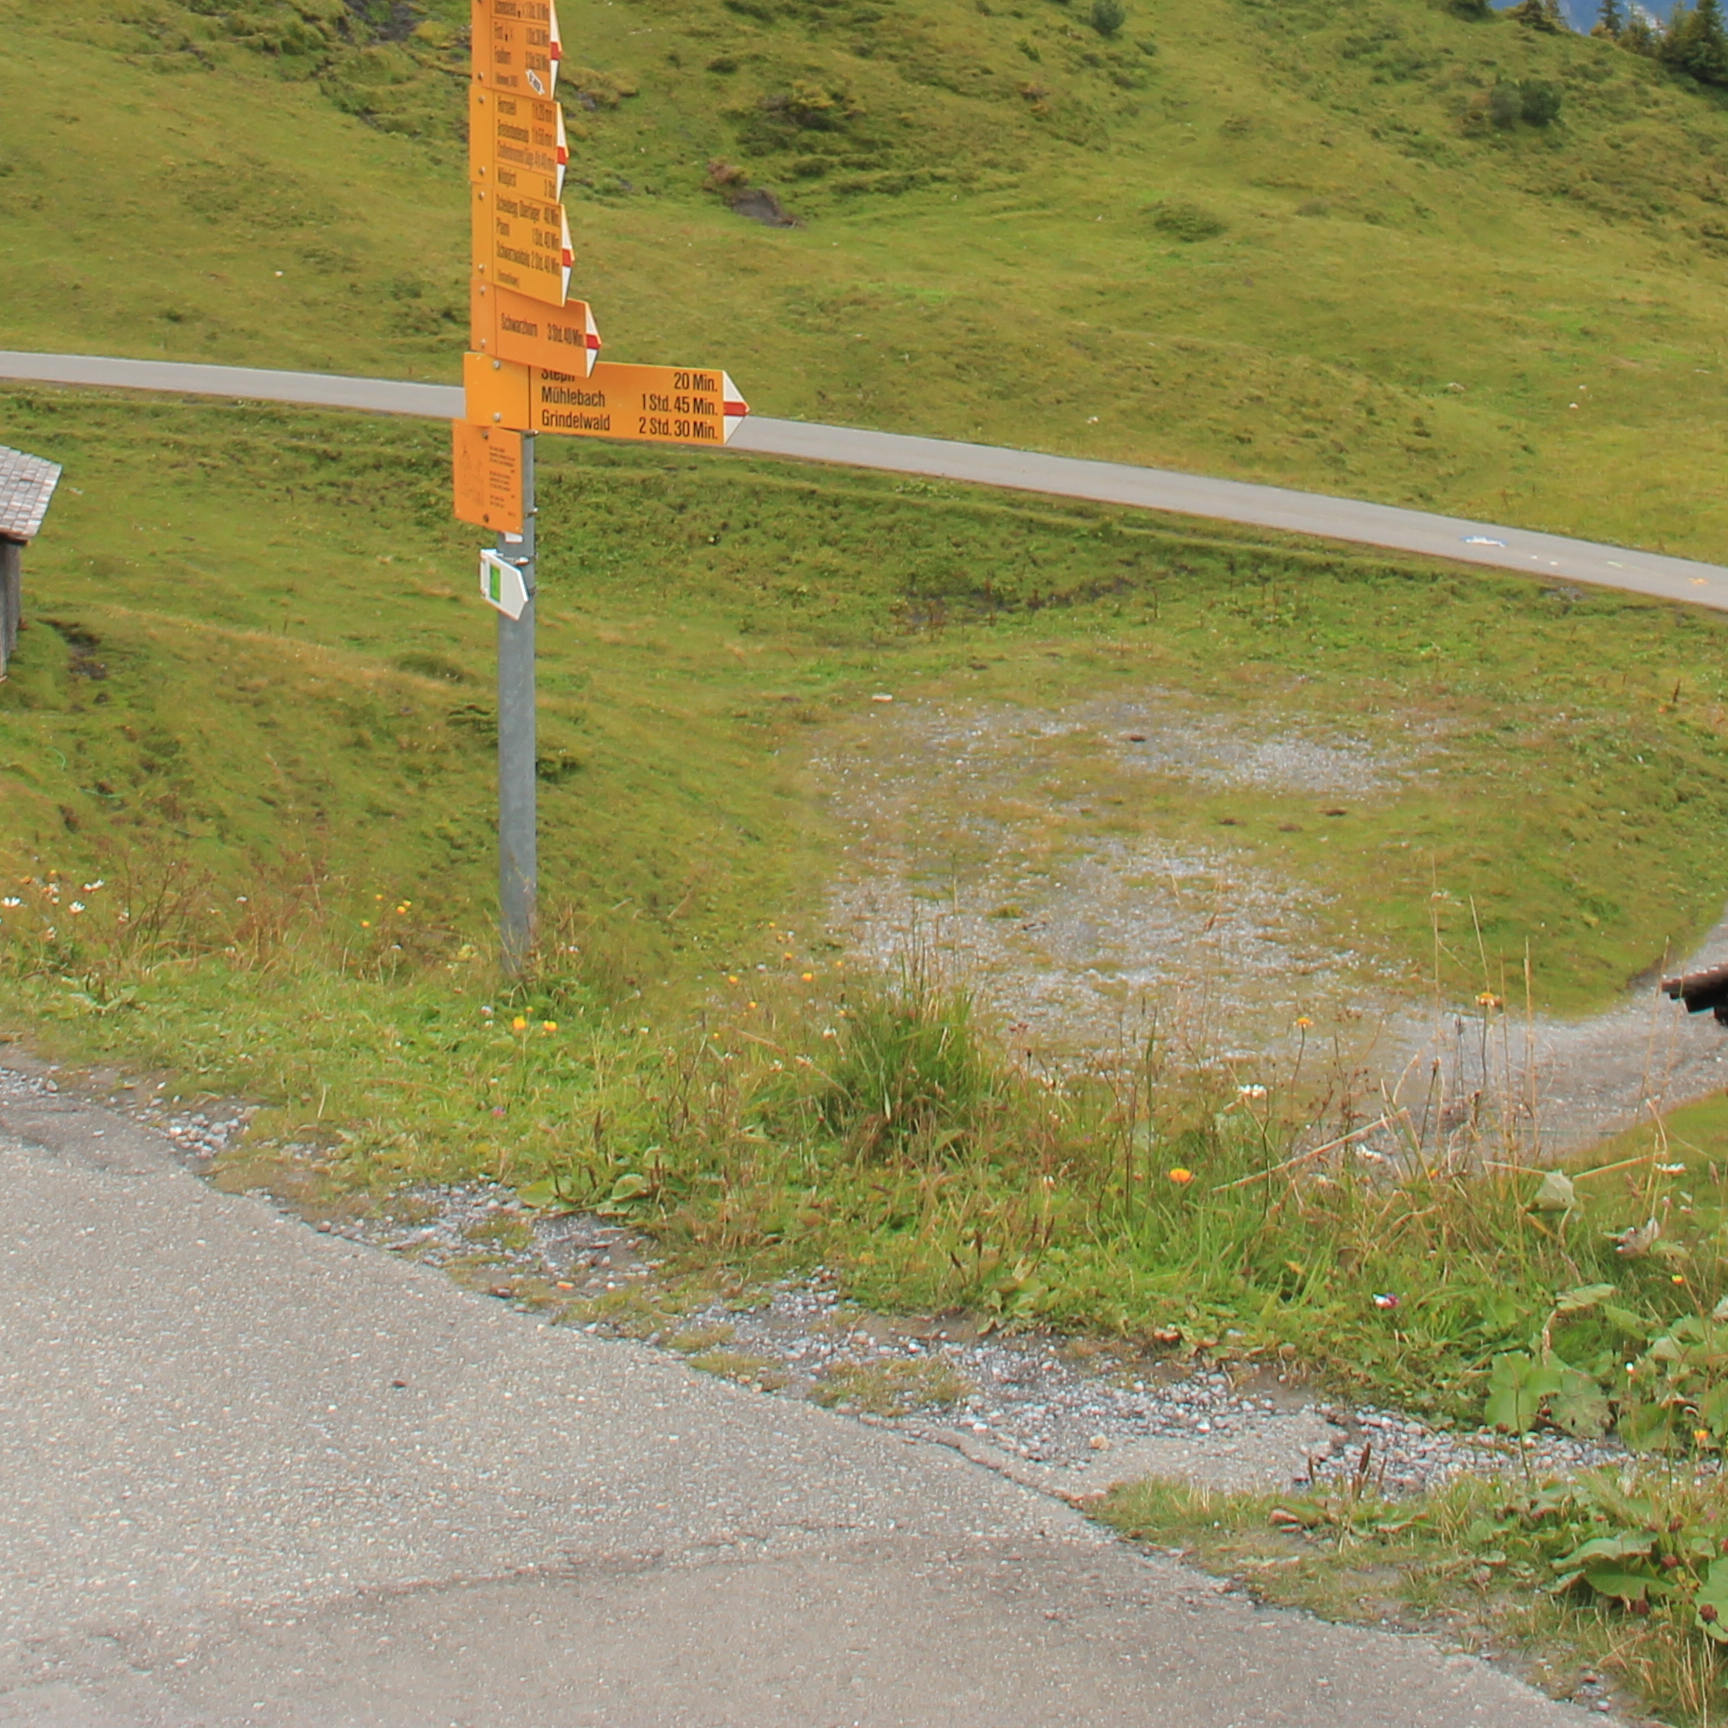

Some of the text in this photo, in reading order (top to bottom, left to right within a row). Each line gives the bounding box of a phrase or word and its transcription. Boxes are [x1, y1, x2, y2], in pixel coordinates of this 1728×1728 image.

[674, 372, 690, 390] 20
[693, 373, 718, 392] Min.
[541, 386, 718, 416] Mühlebach 1 Std. 45 Min.
[541, 409, 718, 439] Grindelwald 2 Std. 30 Min.
